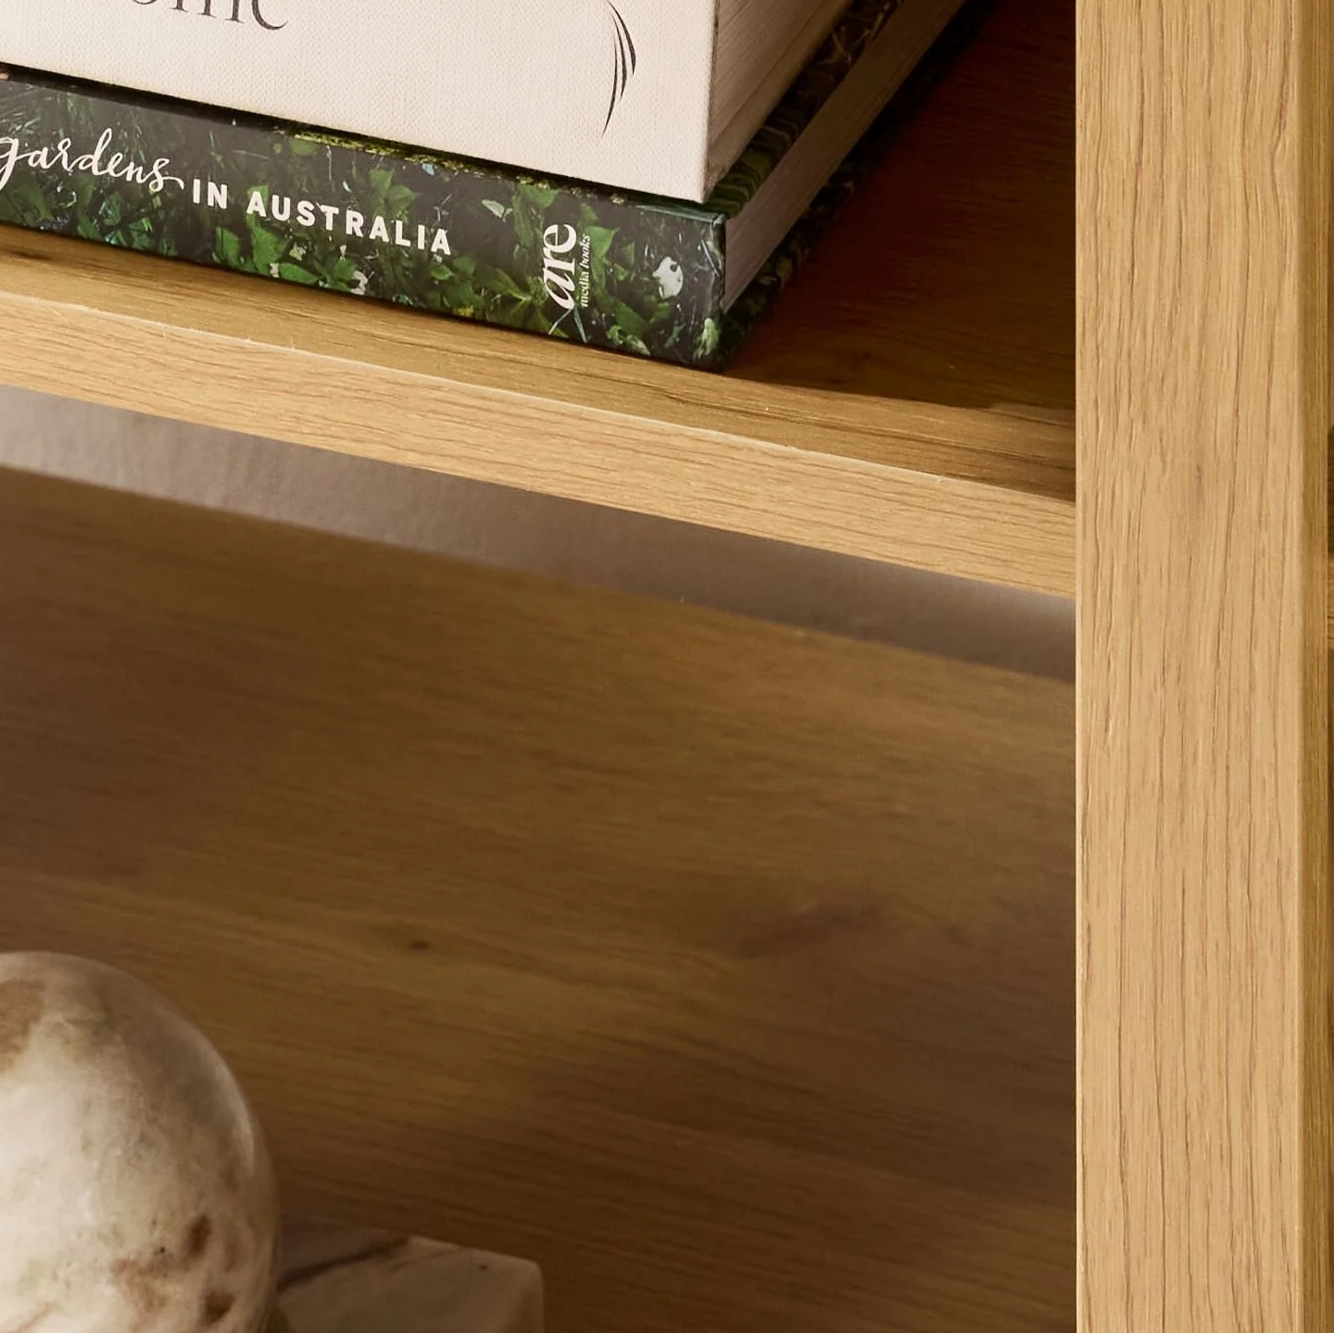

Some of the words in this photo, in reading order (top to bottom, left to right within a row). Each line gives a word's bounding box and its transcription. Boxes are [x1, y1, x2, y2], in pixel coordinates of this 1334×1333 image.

[192, 178, 227, 209] IN
[246, 191, 451, 256] AUSTRALIA
[543, 224, 577, 310] are
[579, 234, 591, 269] books
[579, 271, 590, 308] media
